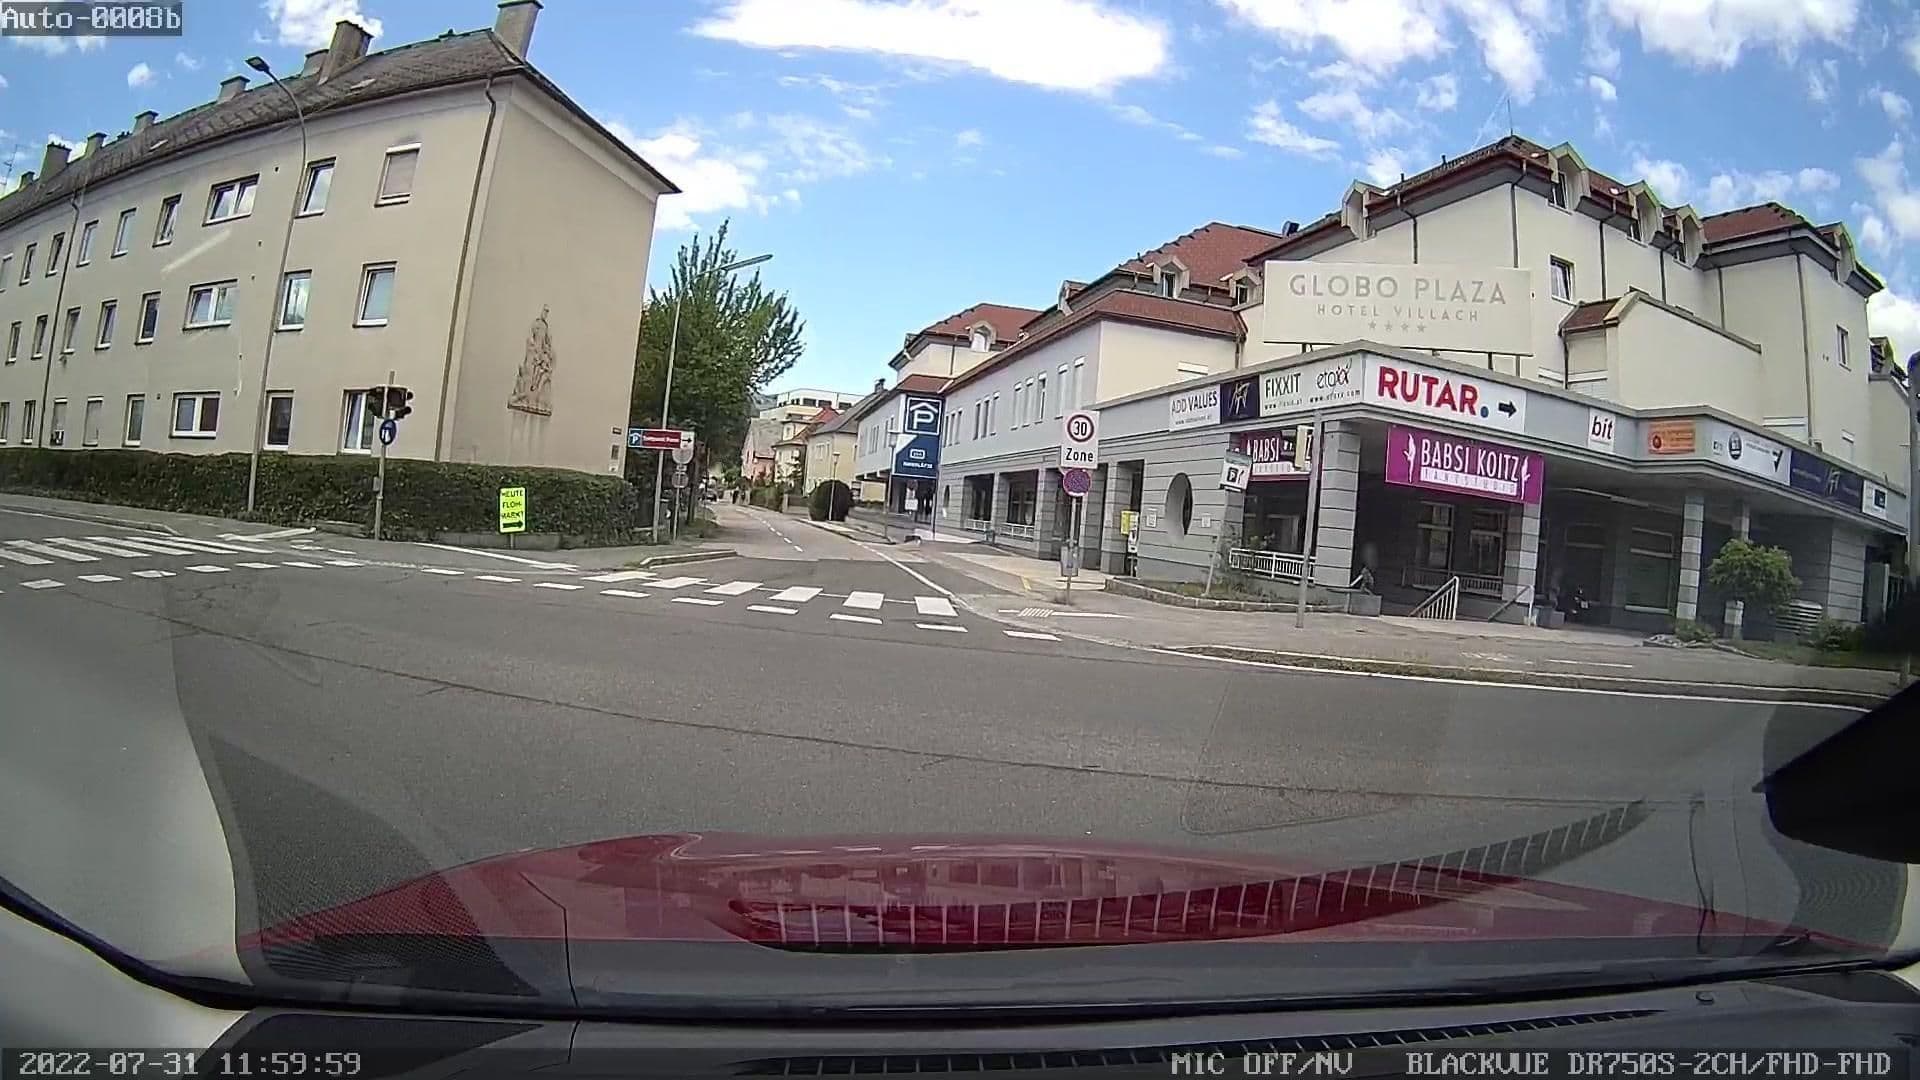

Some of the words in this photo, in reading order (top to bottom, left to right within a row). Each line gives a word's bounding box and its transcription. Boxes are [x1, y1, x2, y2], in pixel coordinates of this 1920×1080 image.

[1290, 273, 1398, 298] GLOBO
[1414, 278, 1506, 305] PLAZA
[1317, 303, 1380, 317] HOTEL
[1393, 306, 1479, 322] VILLACH
[1265, 372, 1302, 399] FIXXIT
[1171, 399, 1187, 415] ADD
[1187, 390, 1218, 412] VALUES
[1073, 421, 1088, 437] 30
[1591, 415, 1613, 439] bit
[1065, 447, 1094, 463] Zone
[1252, 437, 1280, 463] BABSI
[1421, 438, 1470, 473] BABSI
[1476, 447, 1520, 482] KOITZ
